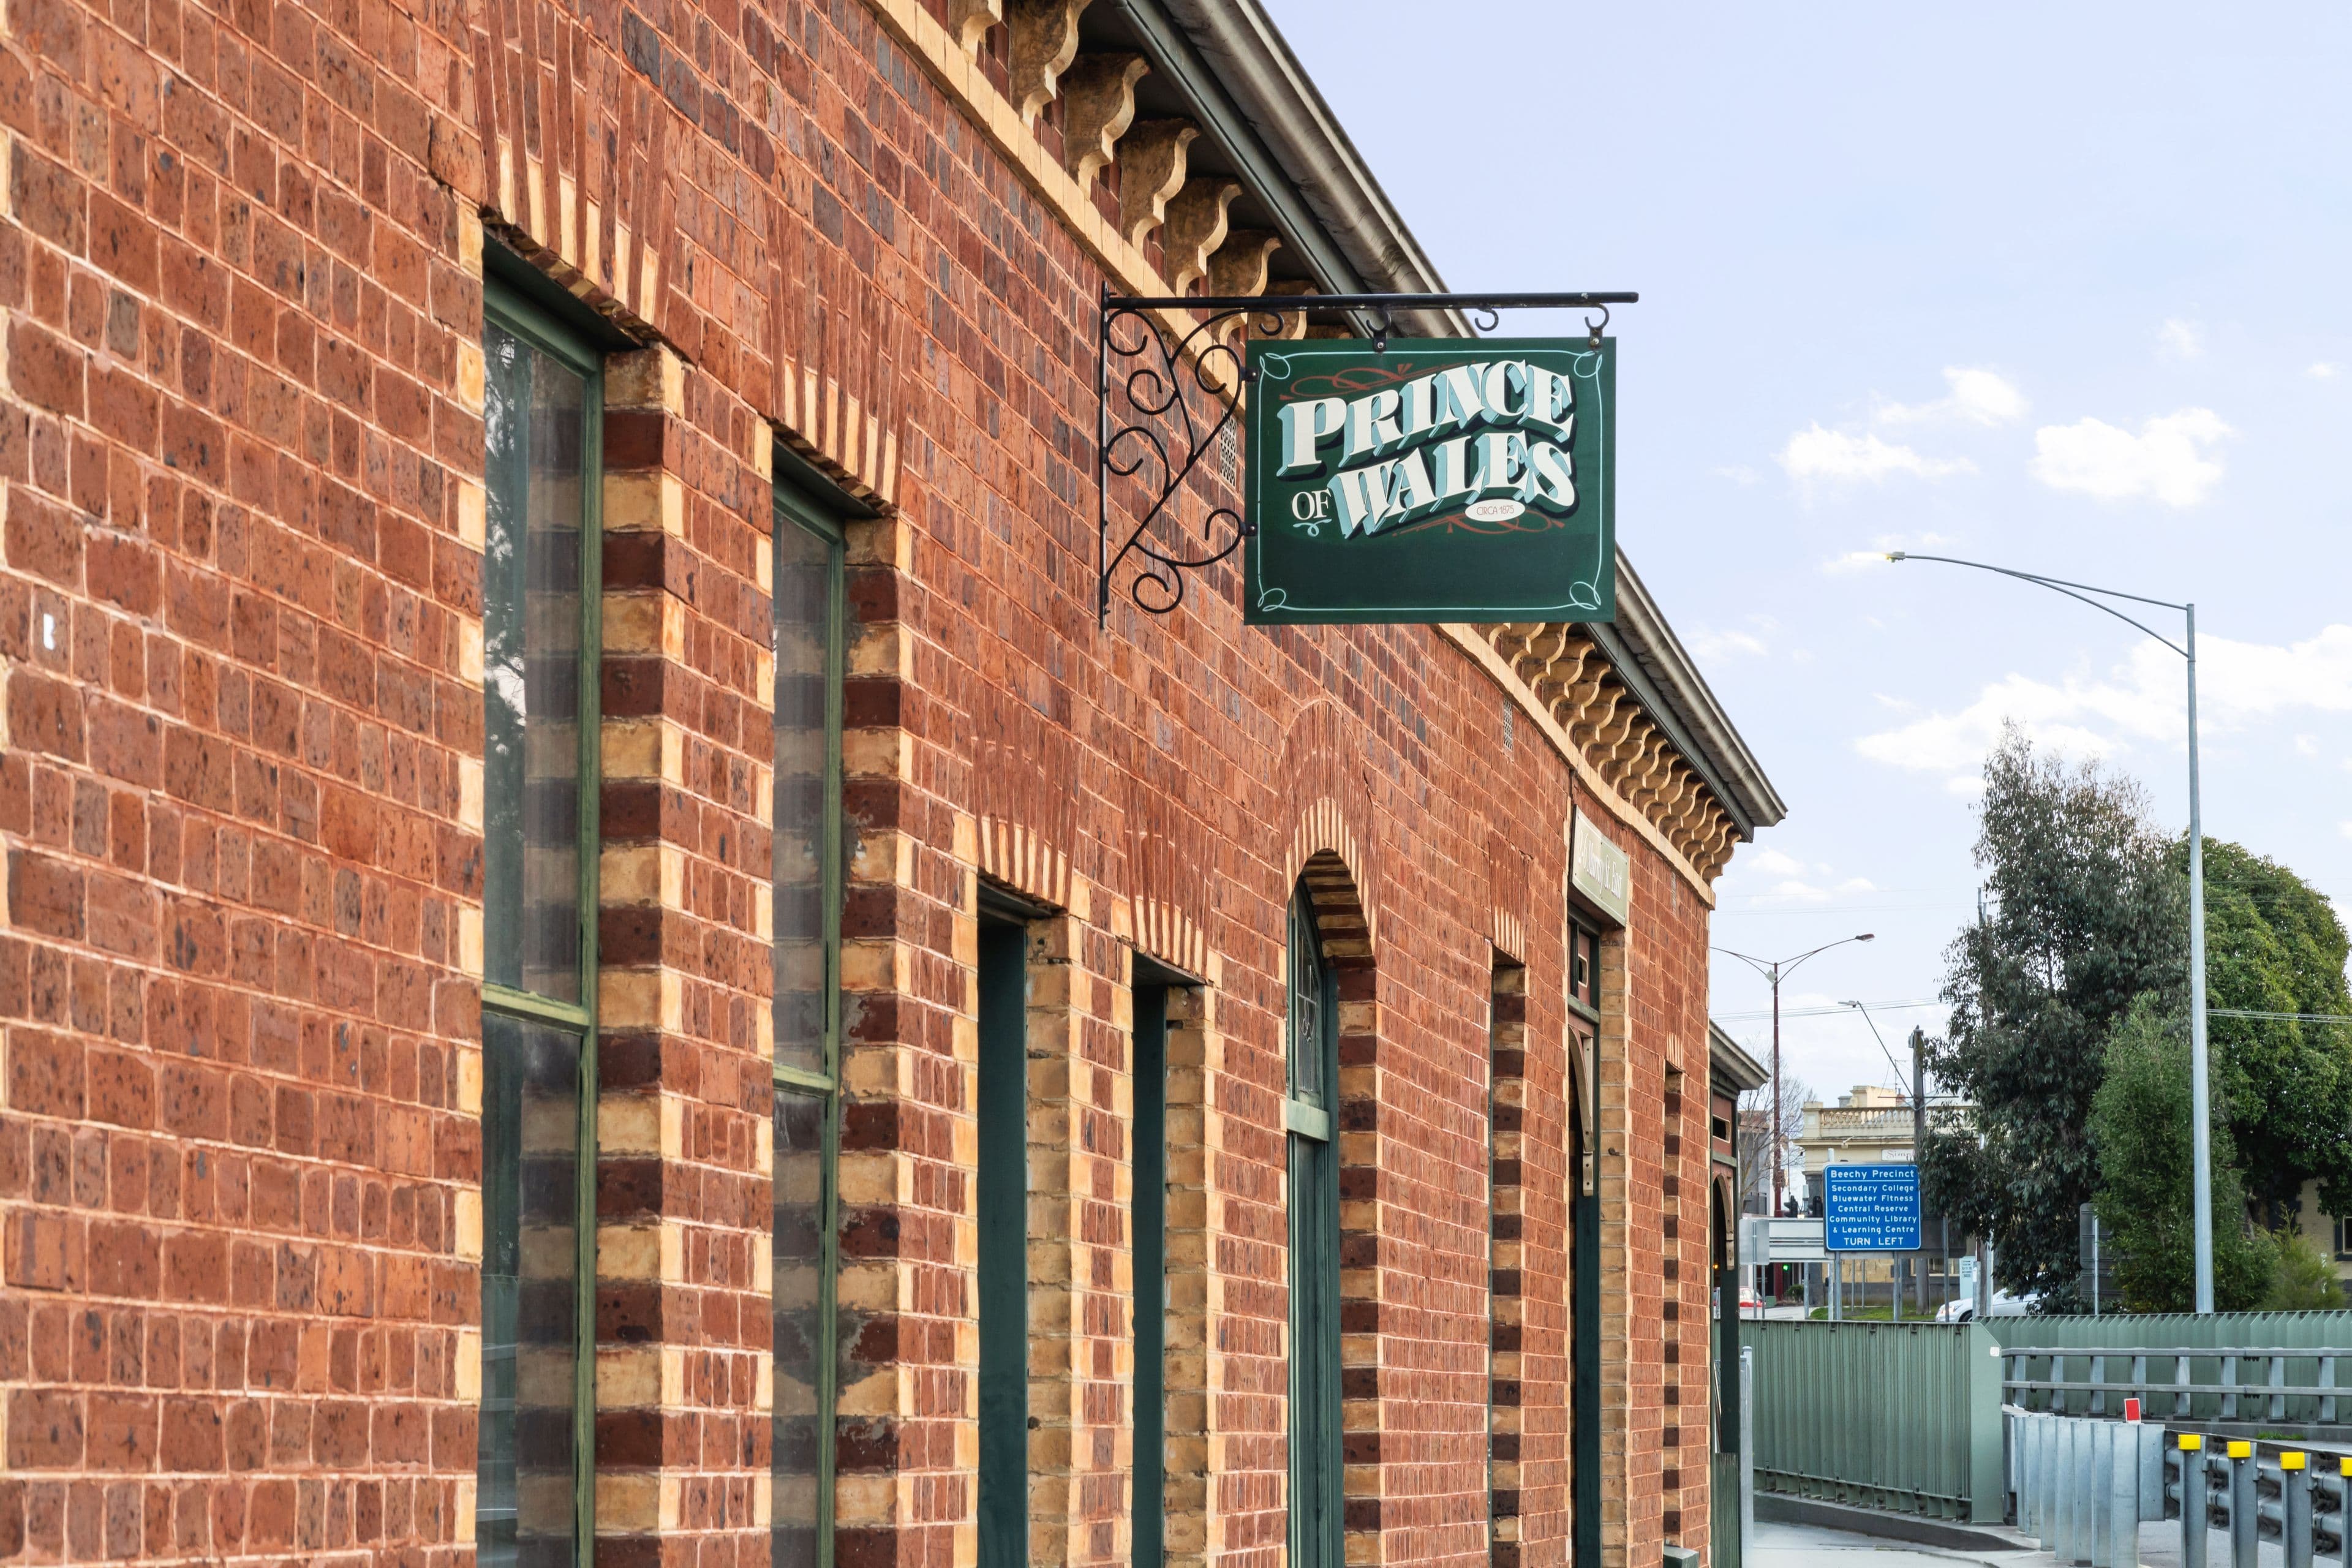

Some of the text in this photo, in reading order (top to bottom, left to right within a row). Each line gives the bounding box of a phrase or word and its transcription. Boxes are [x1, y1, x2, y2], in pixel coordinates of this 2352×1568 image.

[1277, 360, 1577, 477] PRINCE
[1292, 430, 1578, 538] OF WALES
[1476, 505, 1515, 515] CIRCA 1875
[1611, 861, 1623, 900] East
[1831, 1169, 1915, 1180] Beechy Precinct
[1831, 1184, 1914, 1193] Secondary College
[1829, 1215, 1917, 1224] Community Library
